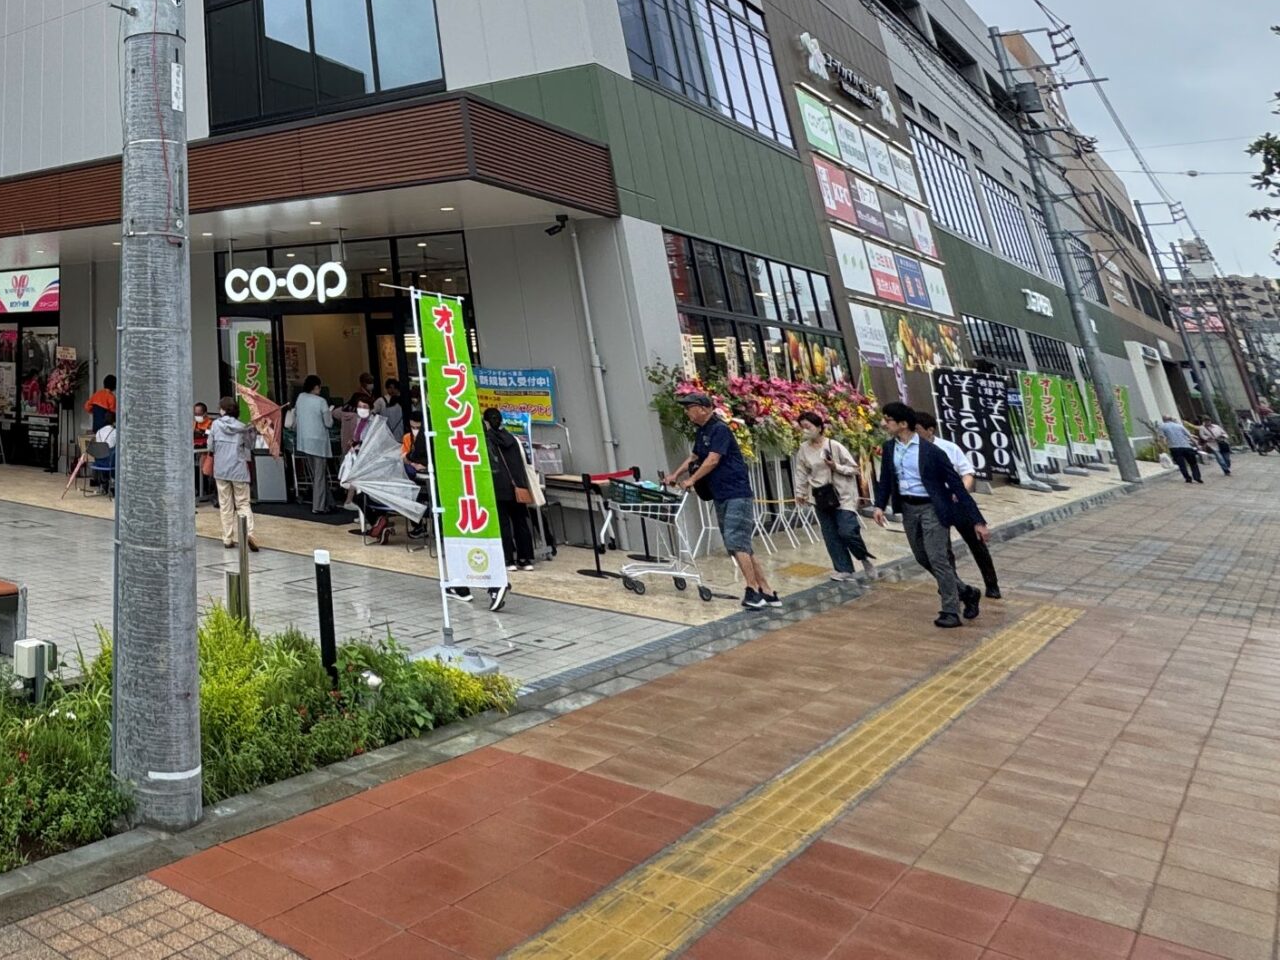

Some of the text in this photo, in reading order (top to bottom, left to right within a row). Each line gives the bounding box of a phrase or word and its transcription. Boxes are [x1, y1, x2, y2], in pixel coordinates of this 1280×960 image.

[245, 335, 260, 391] オープン
[432, 304, 489, 533] オープンセール
[1038, 377, 1059, 443] オープンセール
